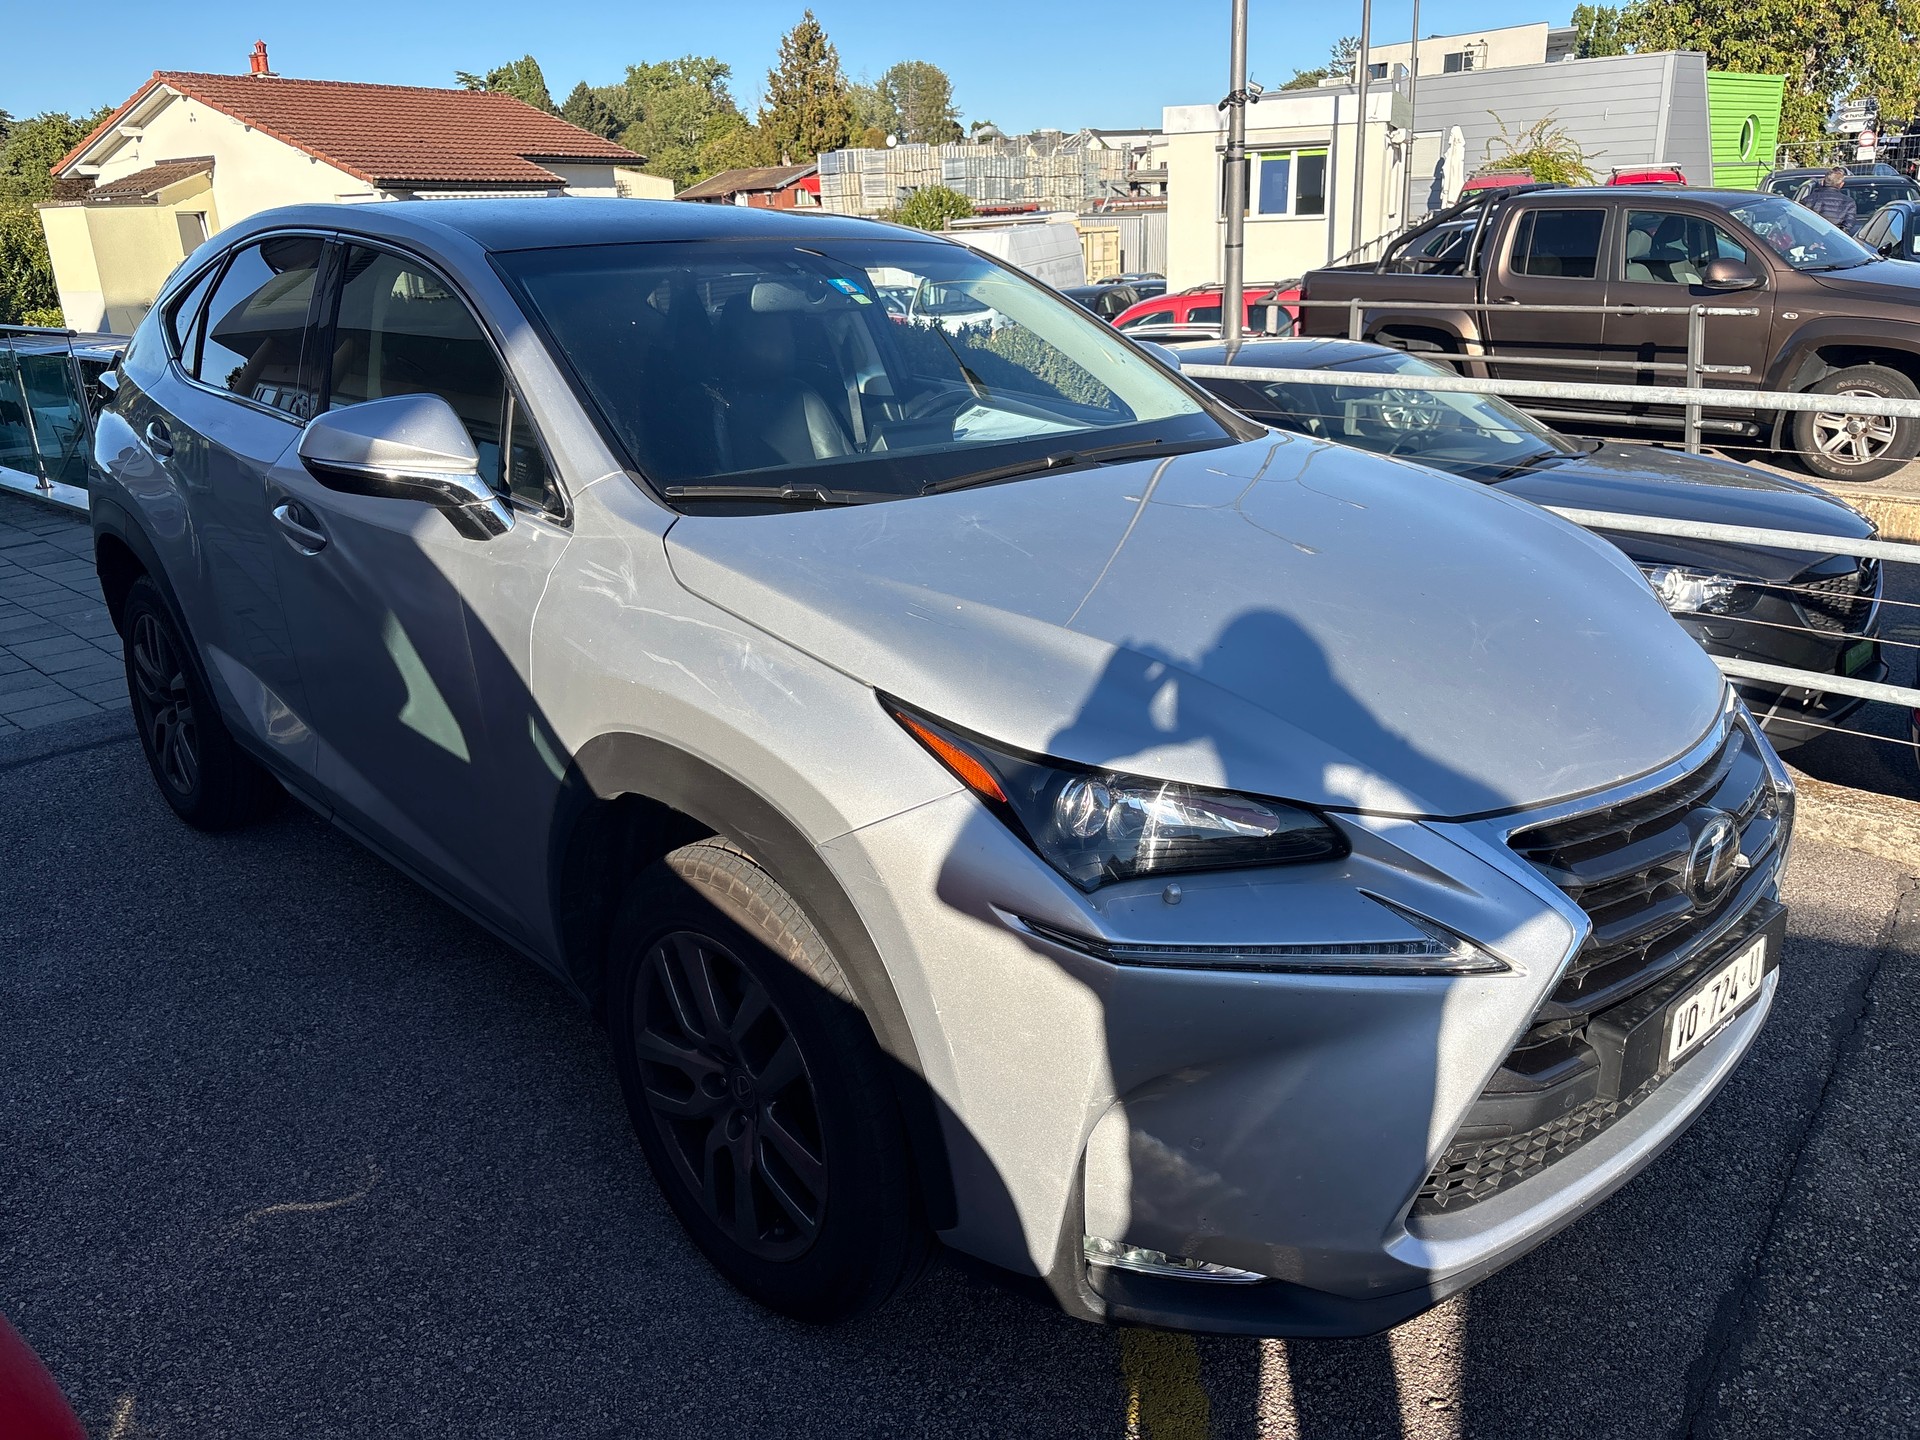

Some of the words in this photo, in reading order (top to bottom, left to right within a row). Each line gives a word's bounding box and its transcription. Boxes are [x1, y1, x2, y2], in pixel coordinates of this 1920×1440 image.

[1677, 1001, 1698, 1050] VD
[1710, 966, 1738, 1024] 724
[1748, 947, 1760, 989] U
